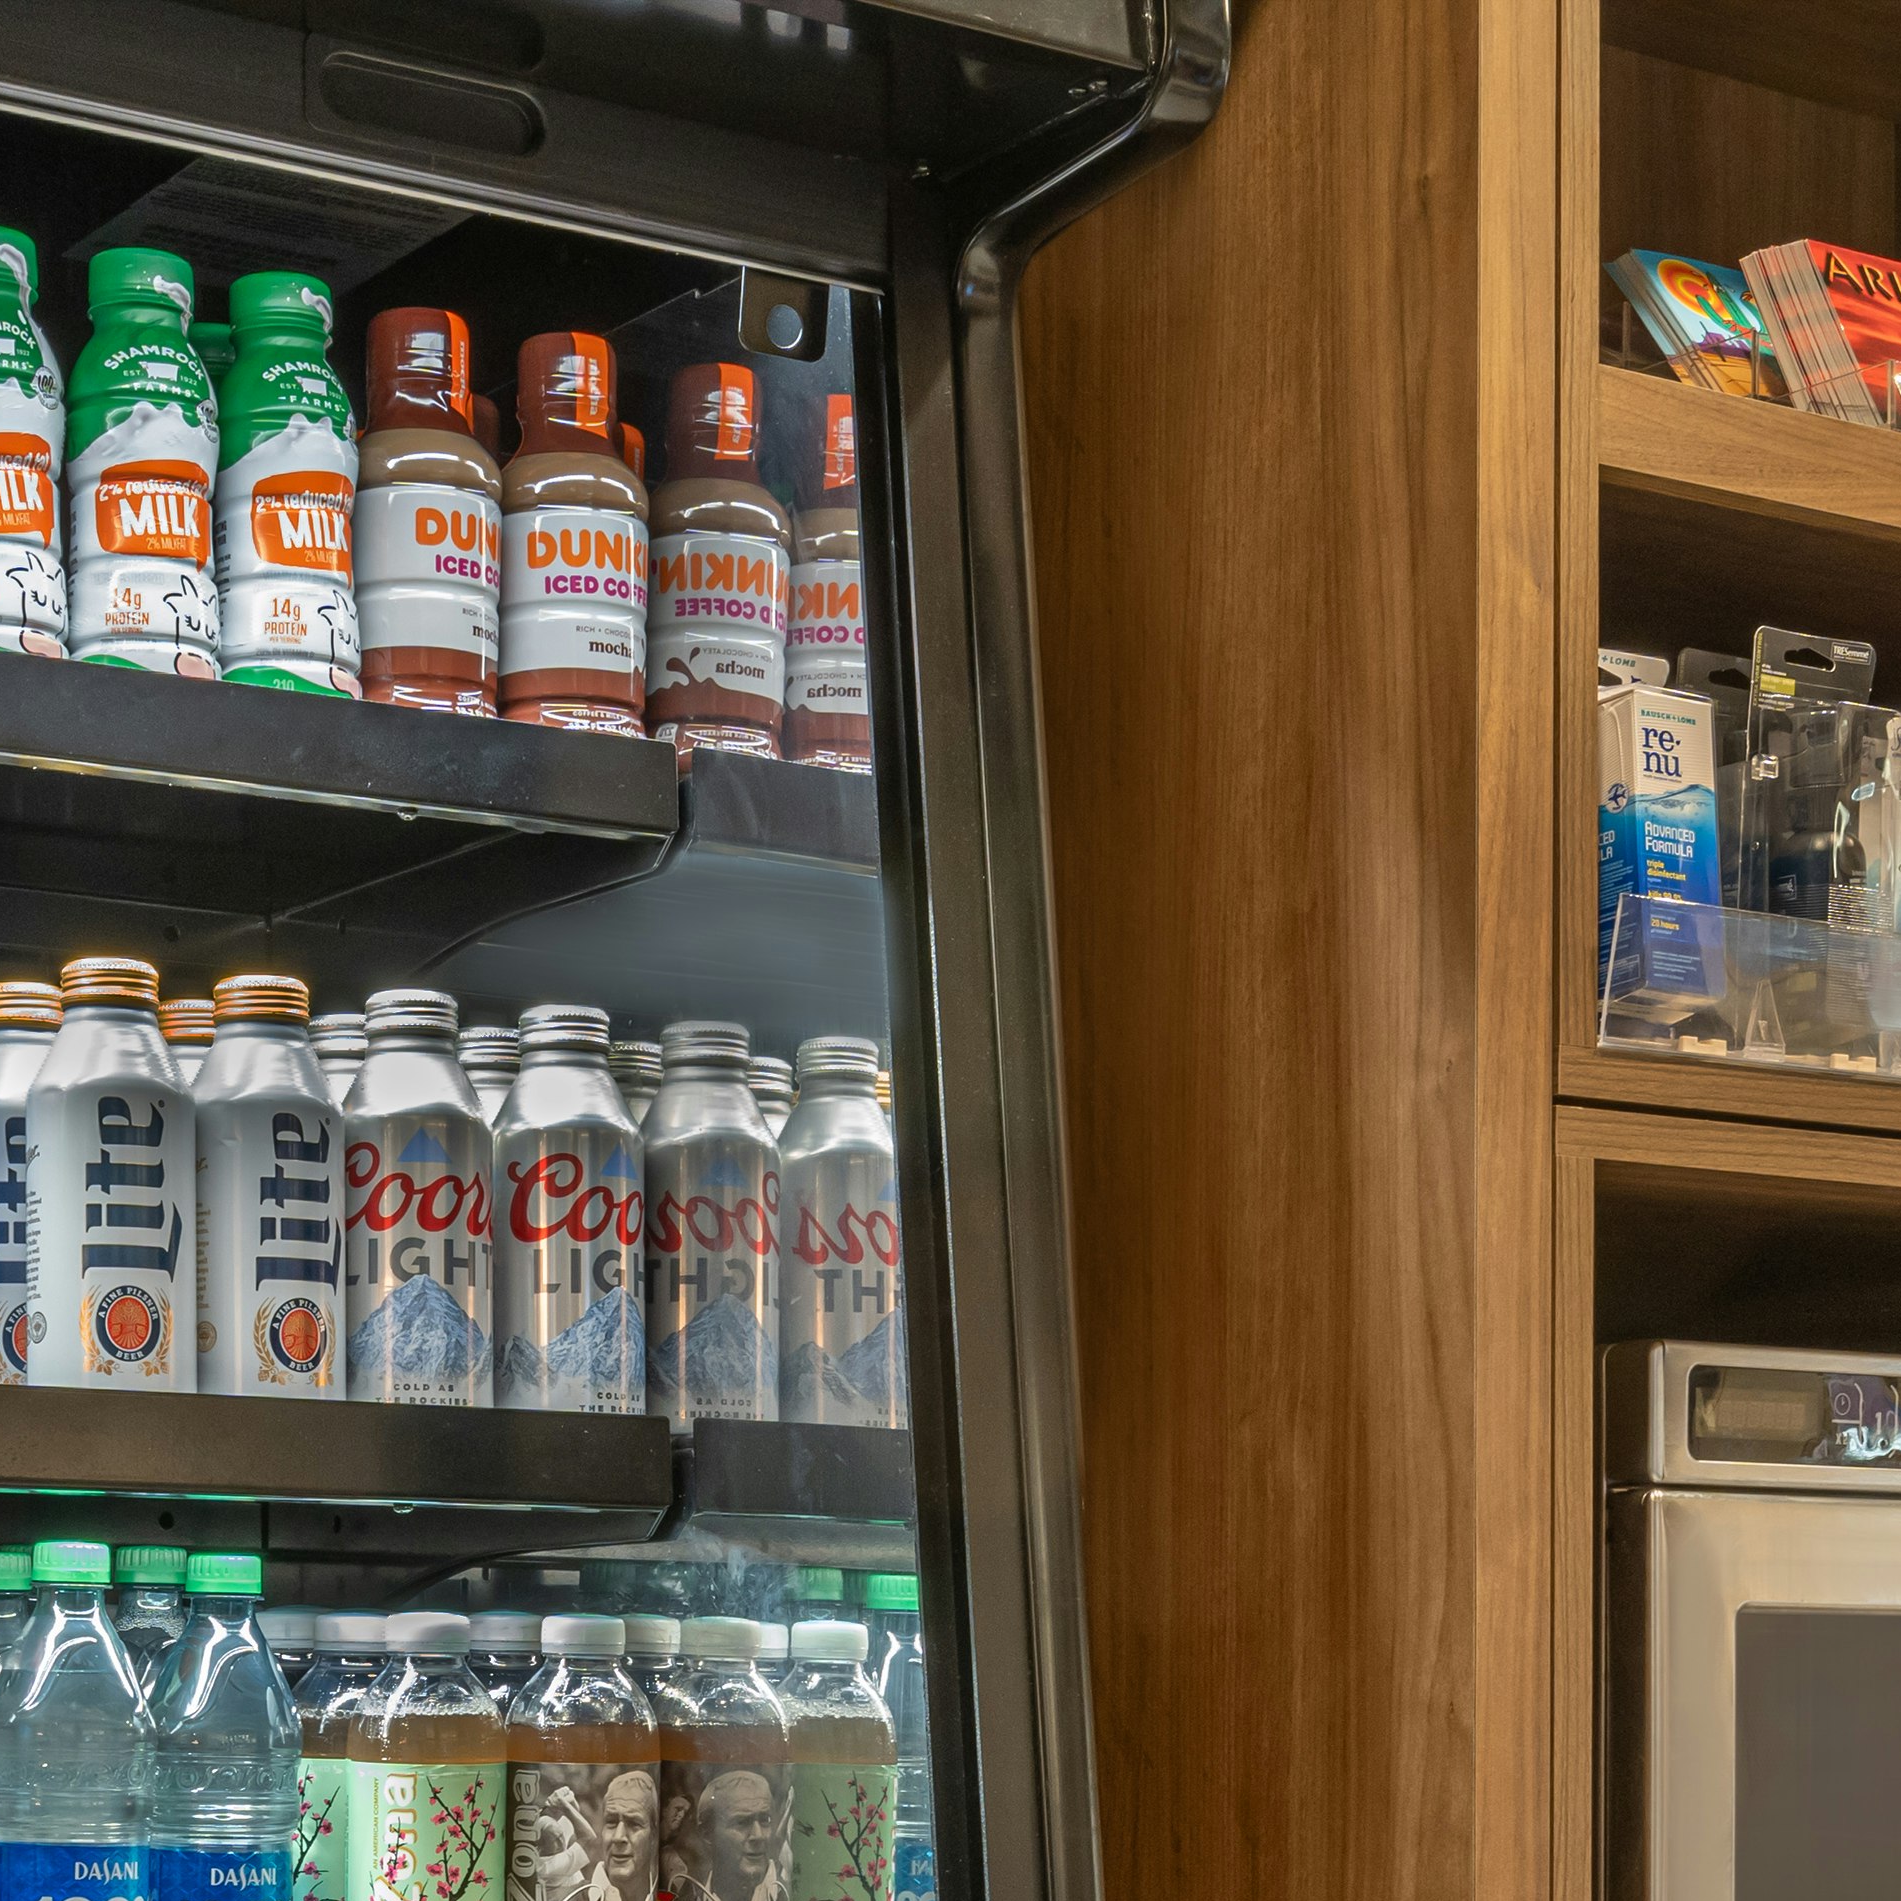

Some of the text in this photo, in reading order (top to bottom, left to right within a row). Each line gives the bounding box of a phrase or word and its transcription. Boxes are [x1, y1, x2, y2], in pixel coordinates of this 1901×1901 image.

[104, 344, 206, 381] SHAMROCK
[118, 497, 201, 538] MILK
[545, 575, 599, 594] ICED
[272, 598, 302, 620] 14g
[1643, 752, 1682, 777] nu
[1645, 821, 1695, 843] ADVANCED
[1645, 836, 1693, 857] FORMULA
[1647, 859, 1664, 869] triple
[1647, 868, 1686, 881] disinfectant
[82, 1093, 182, 1284] Lite
[255, 1113, 340, 1297] Lite
[74, 1859, 138, 1885] DASANI
[210, 1864, 277, 1890] DASANI
